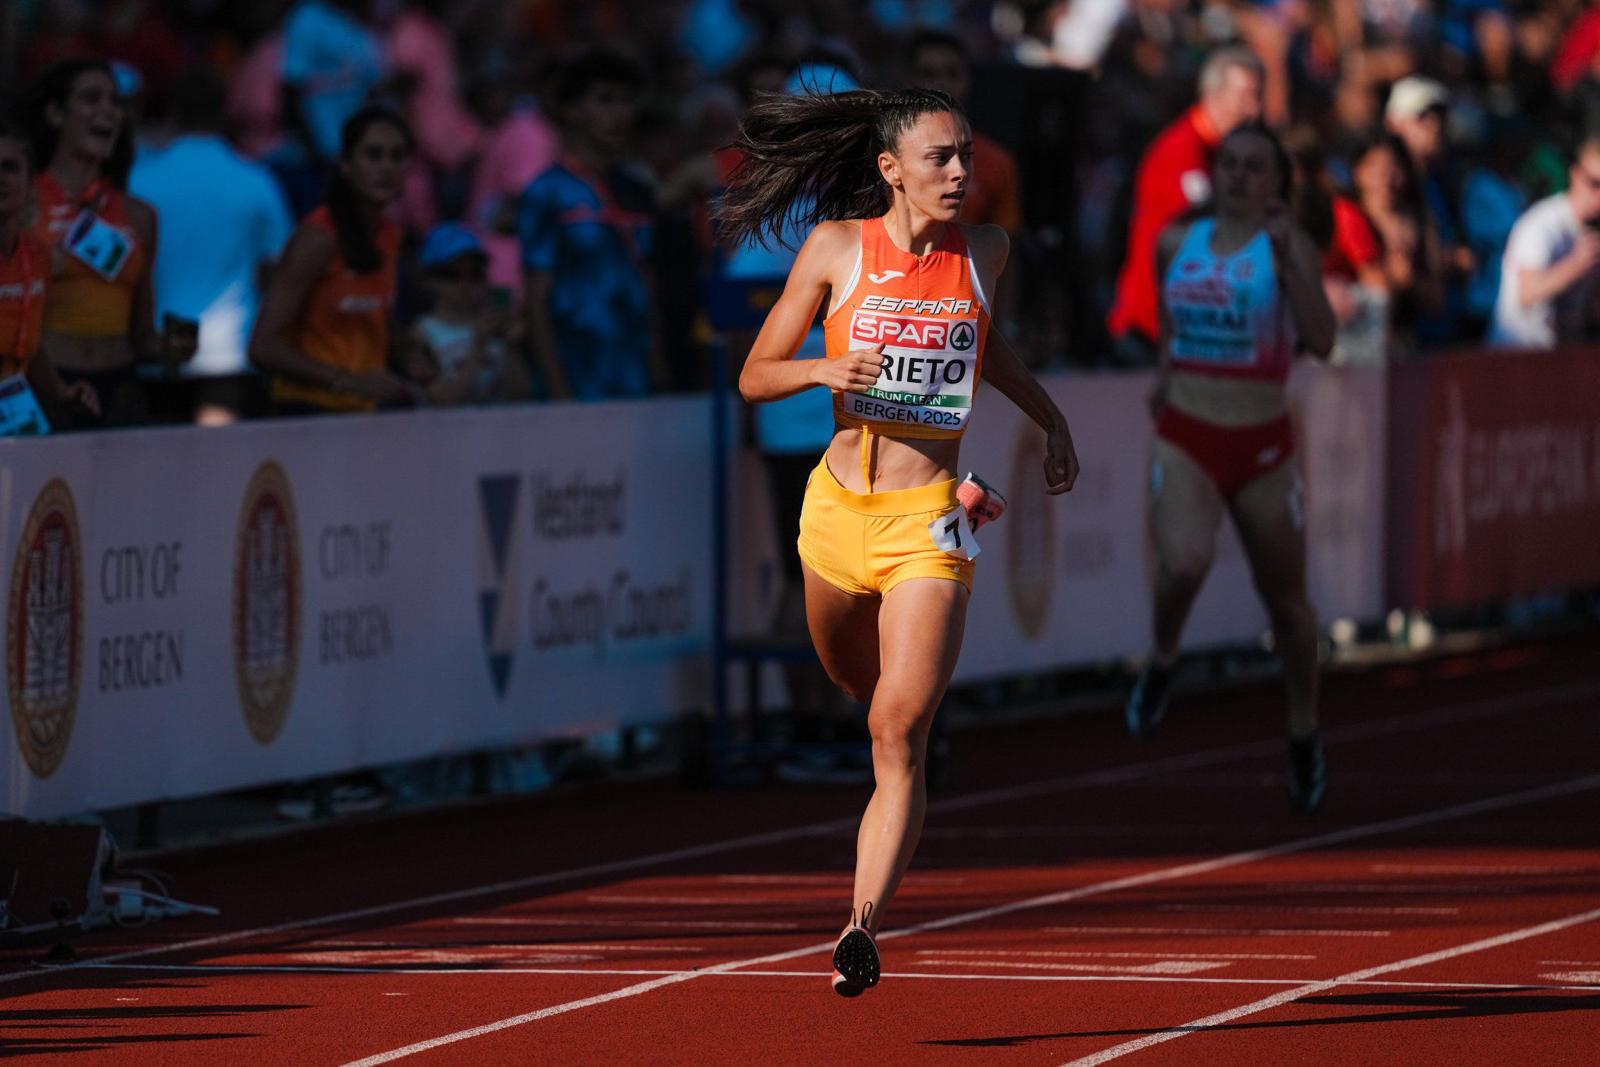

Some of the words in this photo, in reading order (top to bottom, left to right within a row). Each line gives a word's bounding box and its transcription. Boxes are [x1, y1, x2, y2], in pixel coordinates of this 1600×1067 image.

[860, 295, 972, 315] ESPAÑA
[855, 317, 946, 346] SPAR
[880, 354, 966, 384] RIETO
[877, 390, 902, 402] RUN
[854, 399, 919, 423] BERGEN
[923, 411, 961, 425] 2025
[100, 544, 147, 605] CITY
[151, 542, 183, 600] OF
[319, 603, 393, 665] BERGEN
[98, 629, 184, 693] BERGEN
